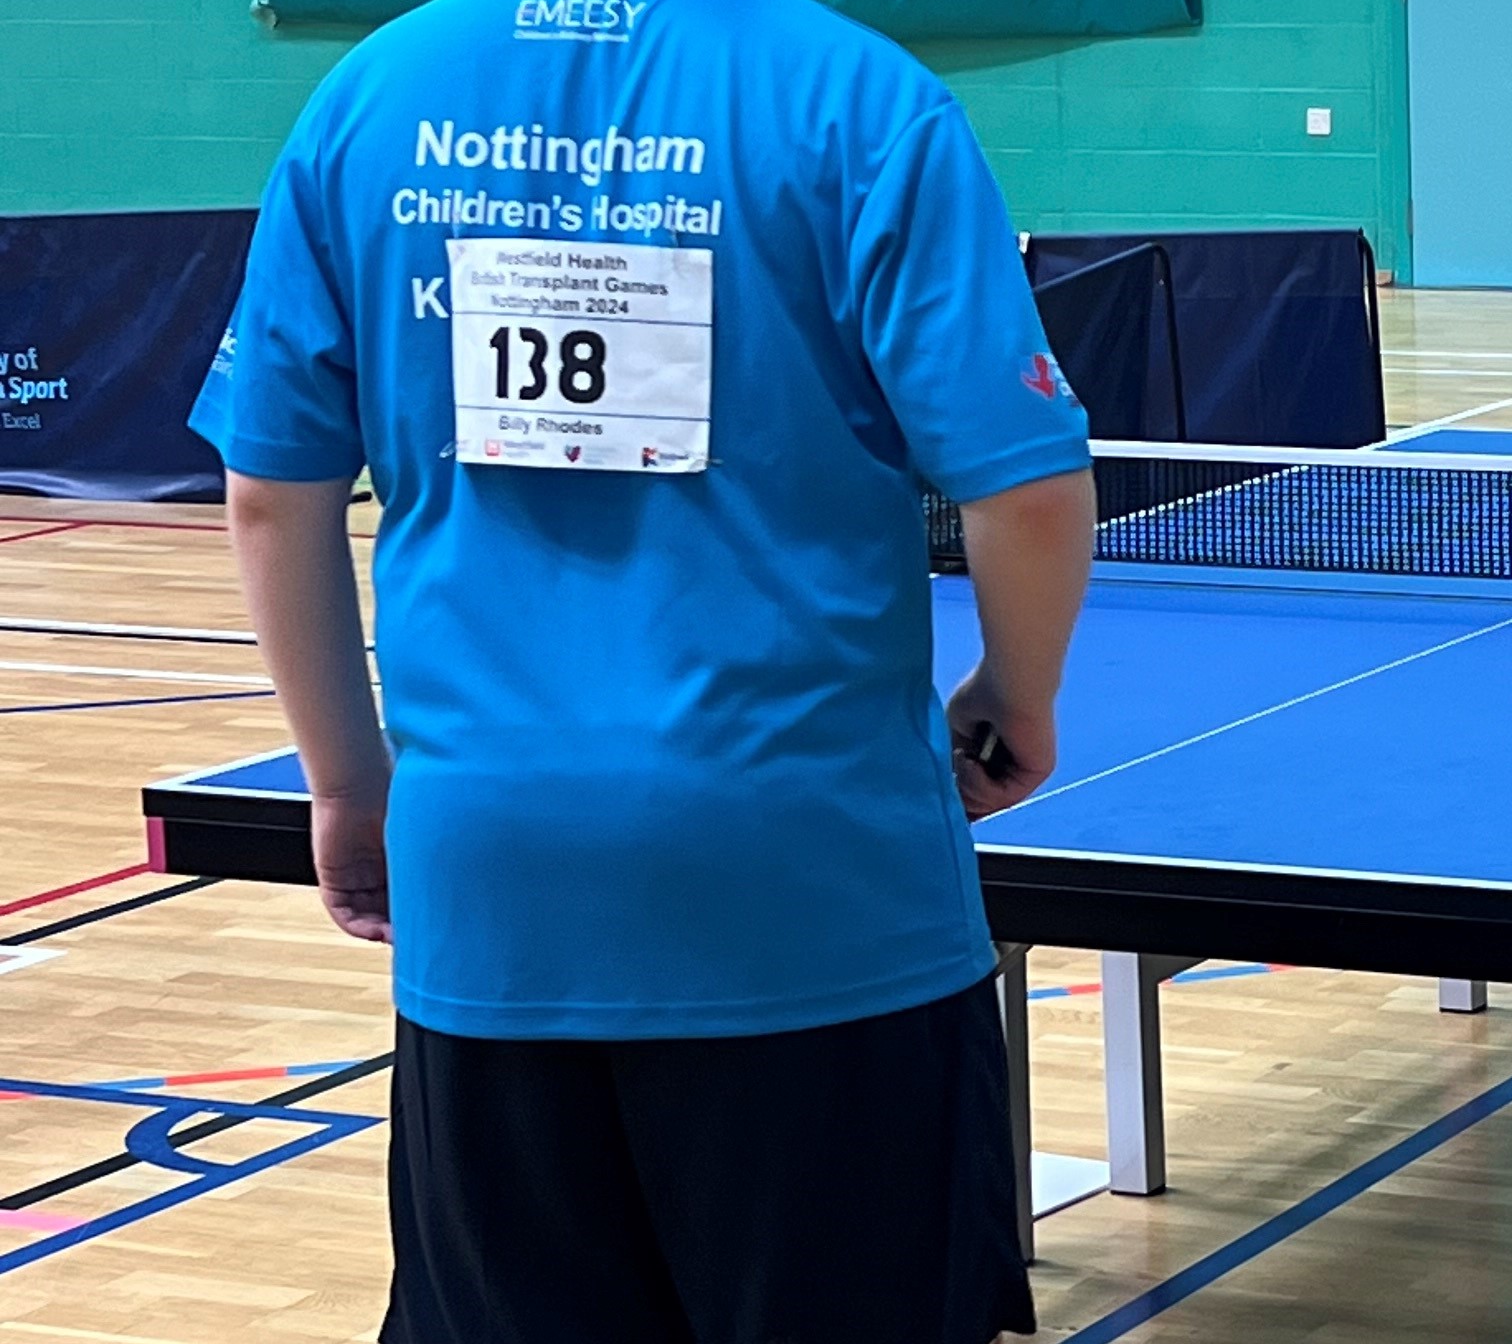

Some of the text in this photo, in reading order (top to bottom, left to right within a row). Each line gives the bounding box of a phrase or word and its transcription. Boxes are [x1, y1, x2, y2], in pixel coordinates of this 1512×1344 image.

[415, 119, 706, 187] Nottingham
[392, 188, 722, 239] Children's Hospital
[567, 253, 628, 271] Health
[605, 276, 669, 296] Games
[585, 297, 629, 315] 2024
[14, 347, 39, 370] of
[489, 326, 607, 404] 138
[8, 376, 69, 404] Sport
[536, 417, 604, 435] Rhodes
